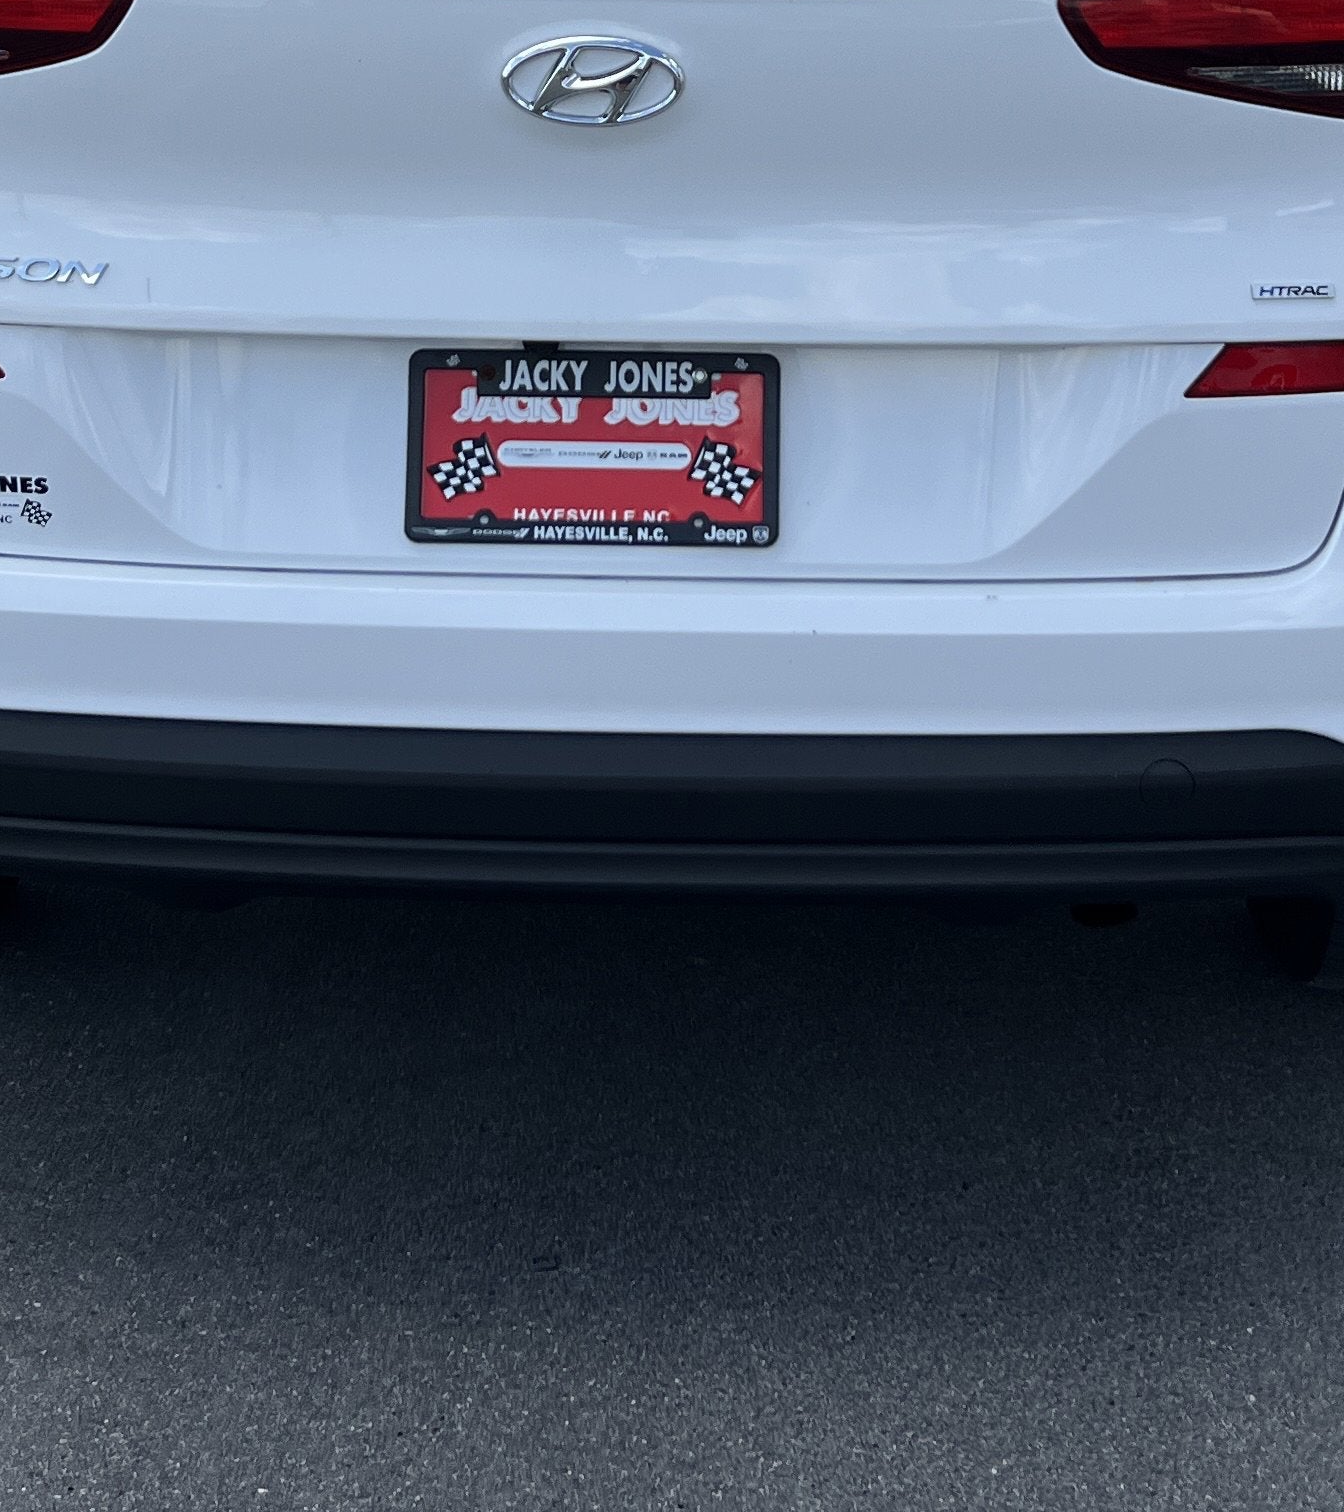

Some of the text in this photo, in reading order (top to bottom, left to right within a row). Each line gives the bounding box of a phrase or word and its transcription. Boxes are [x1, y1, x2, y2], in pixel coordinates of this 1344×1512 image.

[1259, 285, 1329, 296] HTRAC
[499, 359, 694, 394] JACKY JONES
[452, 387, 583, 423] JACKY
[613, 448, 644, 461] Jeep
[533, 525, 669, 544] HAYESVILLE, N.C.
[704, 525, 748, 545] Jeep
